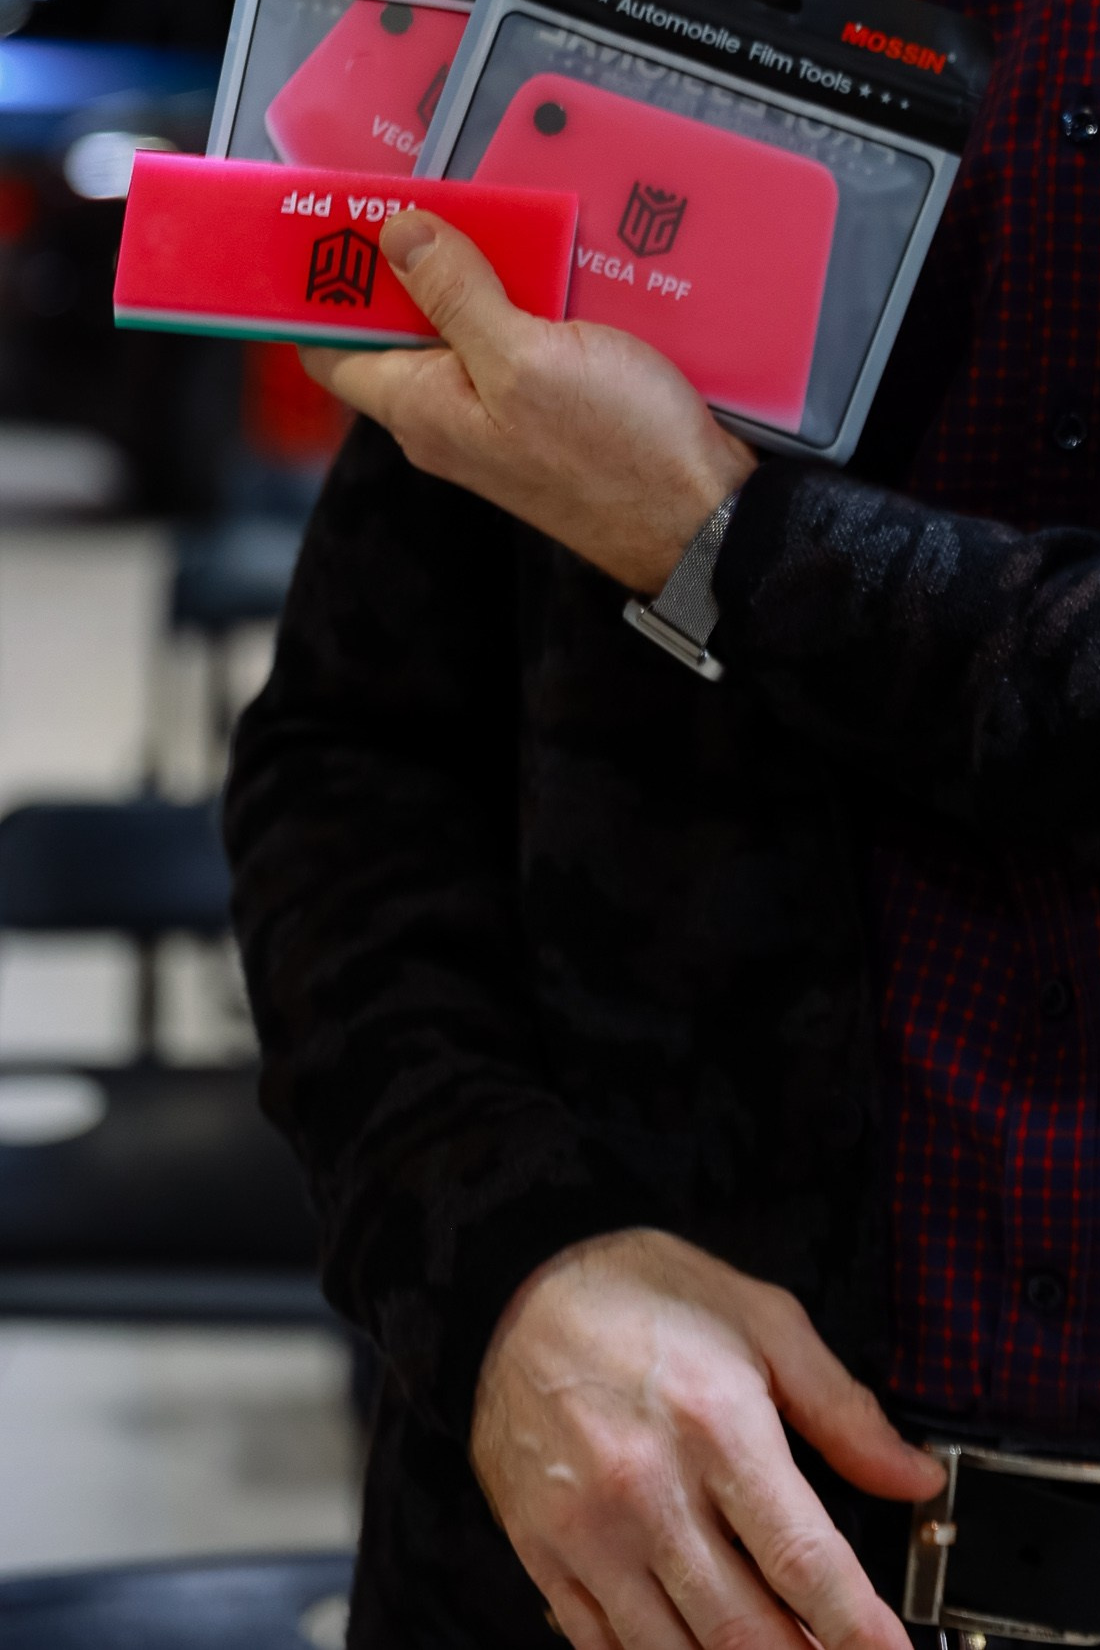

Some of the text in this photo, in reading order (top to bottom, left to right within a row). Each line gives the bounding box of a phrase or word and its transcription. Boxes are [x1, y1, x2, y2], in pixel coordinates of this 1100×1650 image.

[749, 41, 794, 74] Film
[799, 59, 852, 95] Tools
[841, 21, 948, 75] MOSSIN
[281, 191, 332, 218] PPF
[577, 245, 692, 301] VEGA PPF
